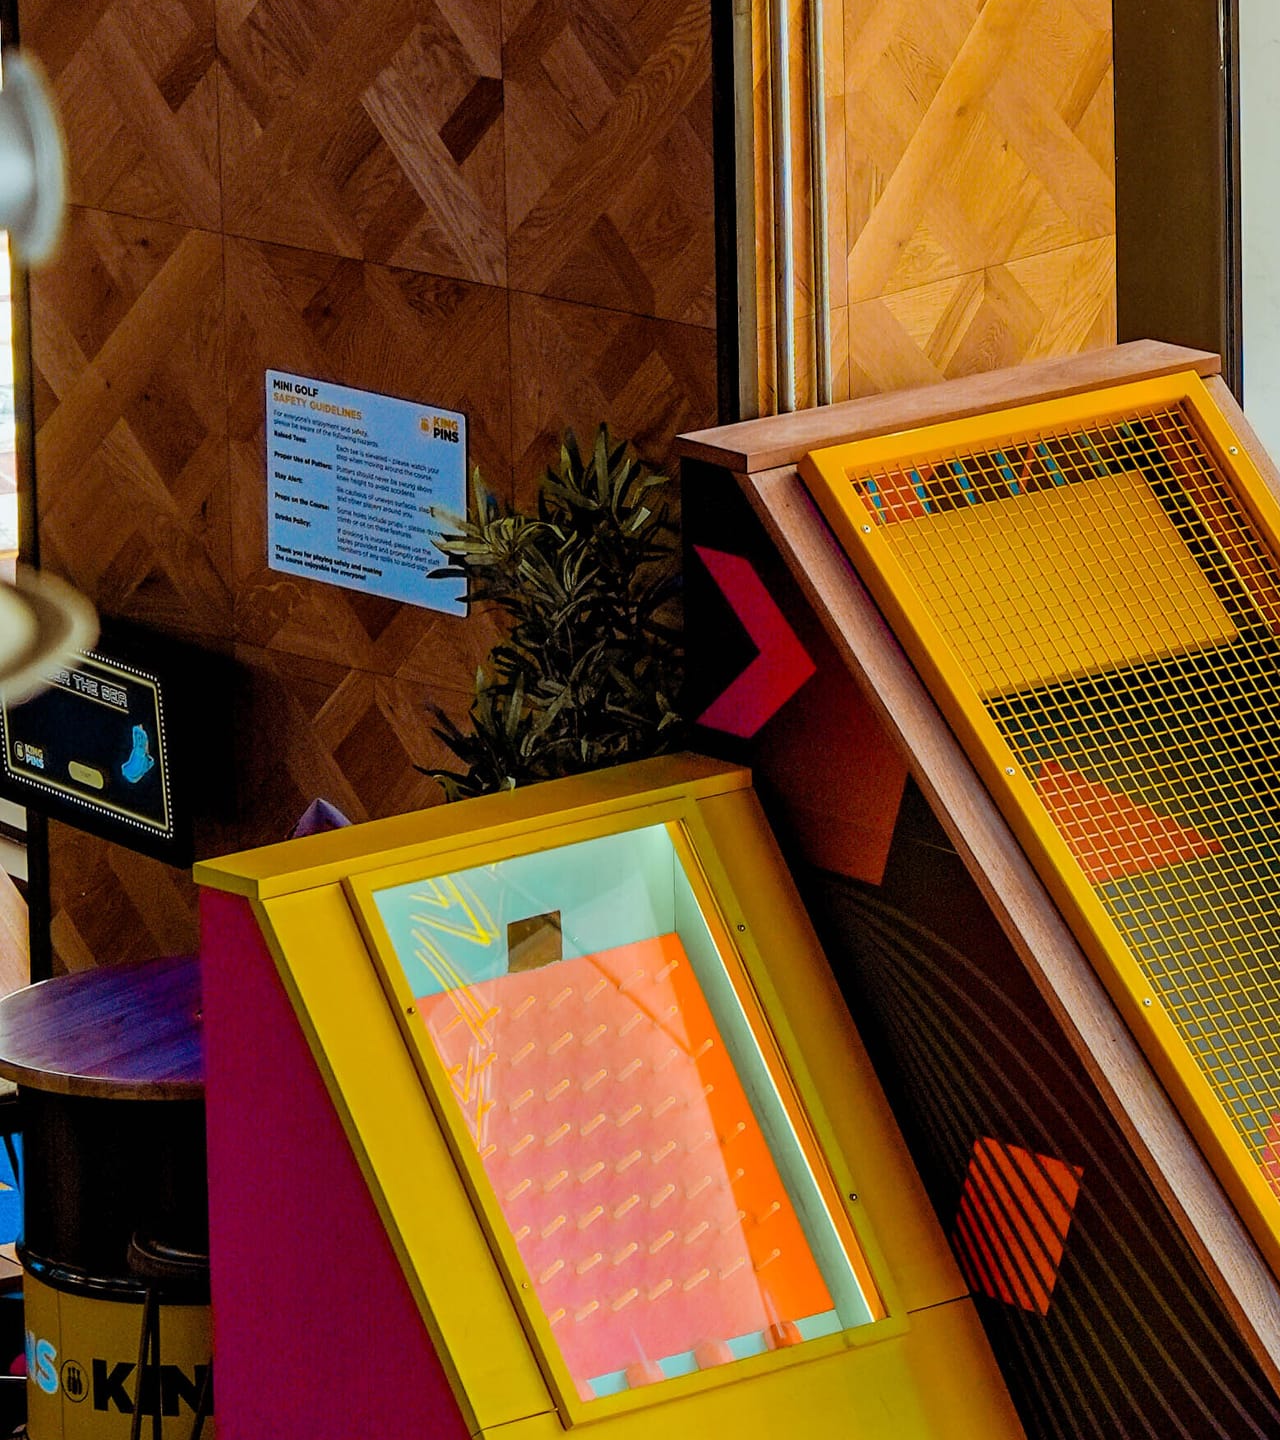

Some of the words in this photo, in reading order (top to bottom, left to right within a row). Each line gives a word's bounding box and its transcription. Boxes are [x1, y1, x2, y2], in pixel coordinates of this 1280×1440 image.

[273, 379, 292, 392] MINI
[295, 384, 319, 398] GOLF
[273, 392, 307, 408] SAFETY
[309, 400, 362, 421] GUIDELINES
[433, 416, 458, 431] KING
[433, 427, 459, 444] PINS
